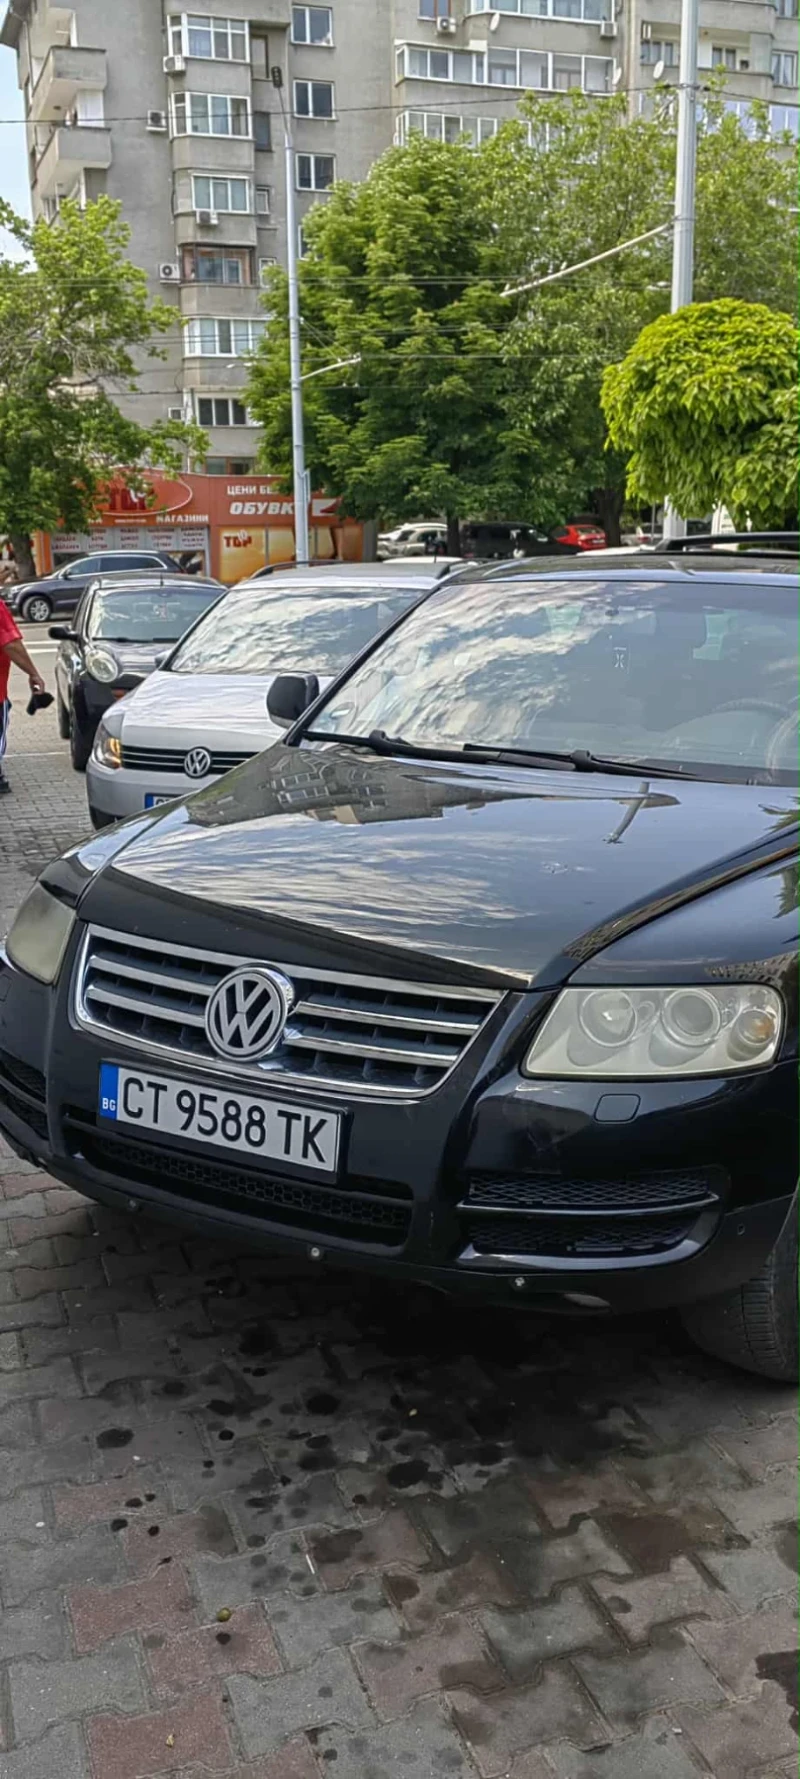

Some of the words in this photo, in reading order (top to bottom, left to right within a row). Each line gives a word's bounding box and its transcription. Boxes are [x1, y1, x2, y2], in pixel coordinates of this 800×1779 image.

[227, 485, 257, 496] ЦЕНИ
[229, 501, 295, 515] ОБУВК
[101, 1097, 116, 1111] BG
[122, 1076, 168, 1124] CT
[175, 1089, 266, 1148] 9588
[276, 1109, 328, 1163] TK
